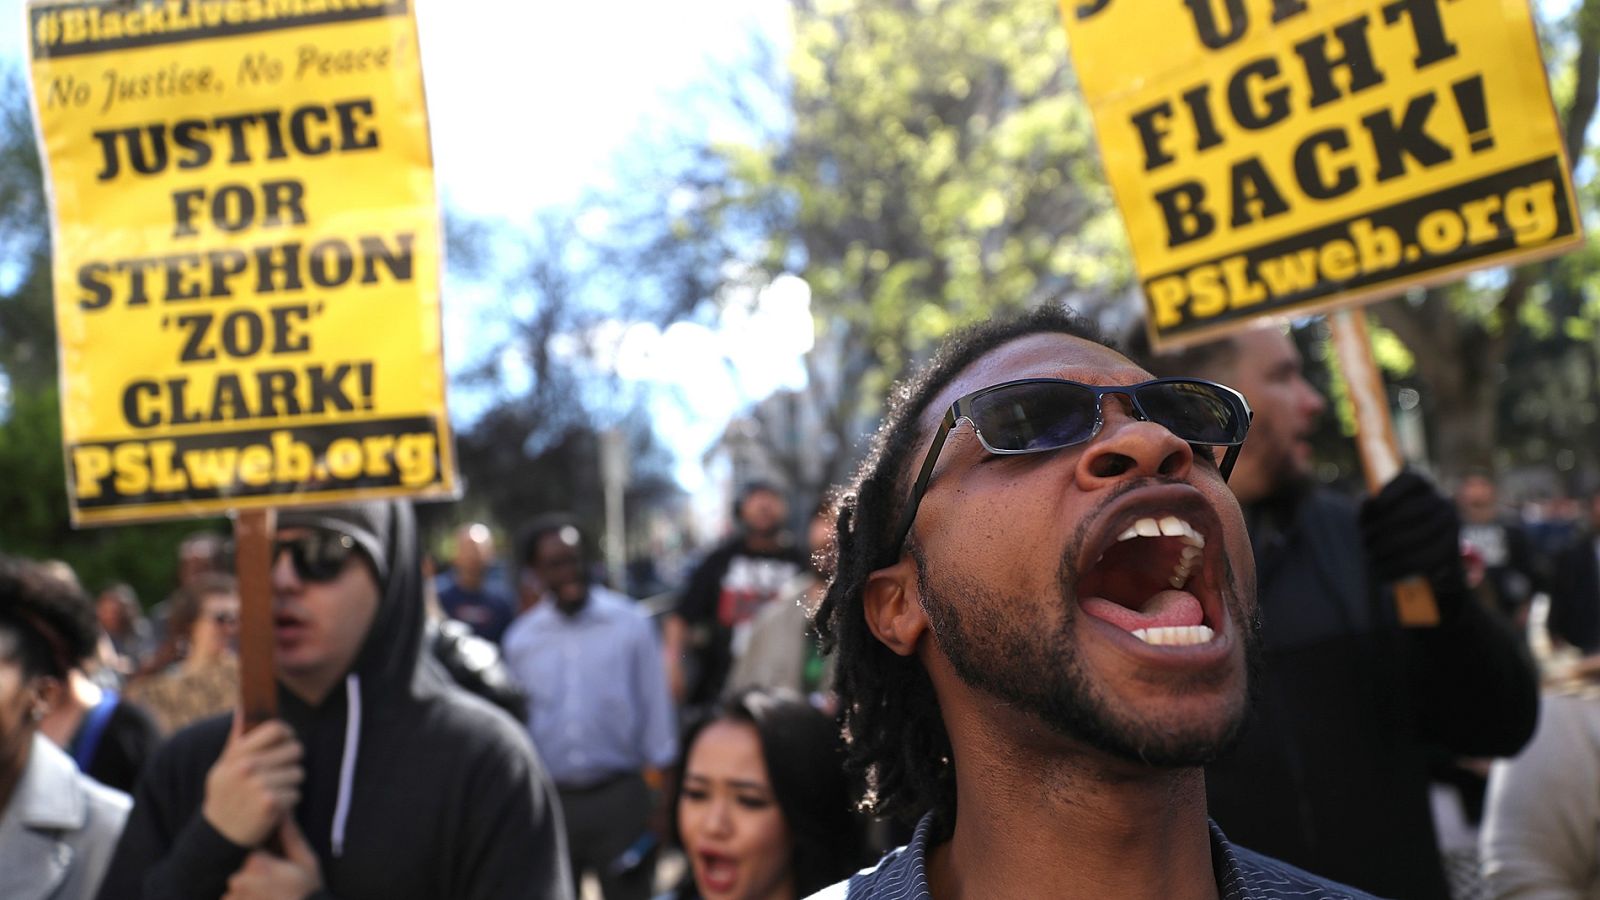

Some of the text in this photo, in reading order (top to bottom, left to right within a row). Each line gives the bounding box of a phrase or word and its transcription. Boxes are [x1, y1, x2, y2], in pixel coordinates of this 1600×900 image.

[36, 0, 398, 47] #BlackLivesMa
[1182, 0, 1308, 49] U
[48, 77, 91, 110] No
[102, 61, 224, 115] Justice,
[238, 53, 283, 85] No
[1131, 0, 1458, 172] FIGHT
[93, 99, 378, 182] JUSTICE
[1154, 75, 1496, 248] BACK!
[171, 179, 308, 238] FOR
[77, 234, 414, 310] STEPHON
[1148, 179, 1557, 330] PSLweb.org
[122, 362, 375, 428] CLARK!
[73, 432, 437, 499] PSLweb.org
